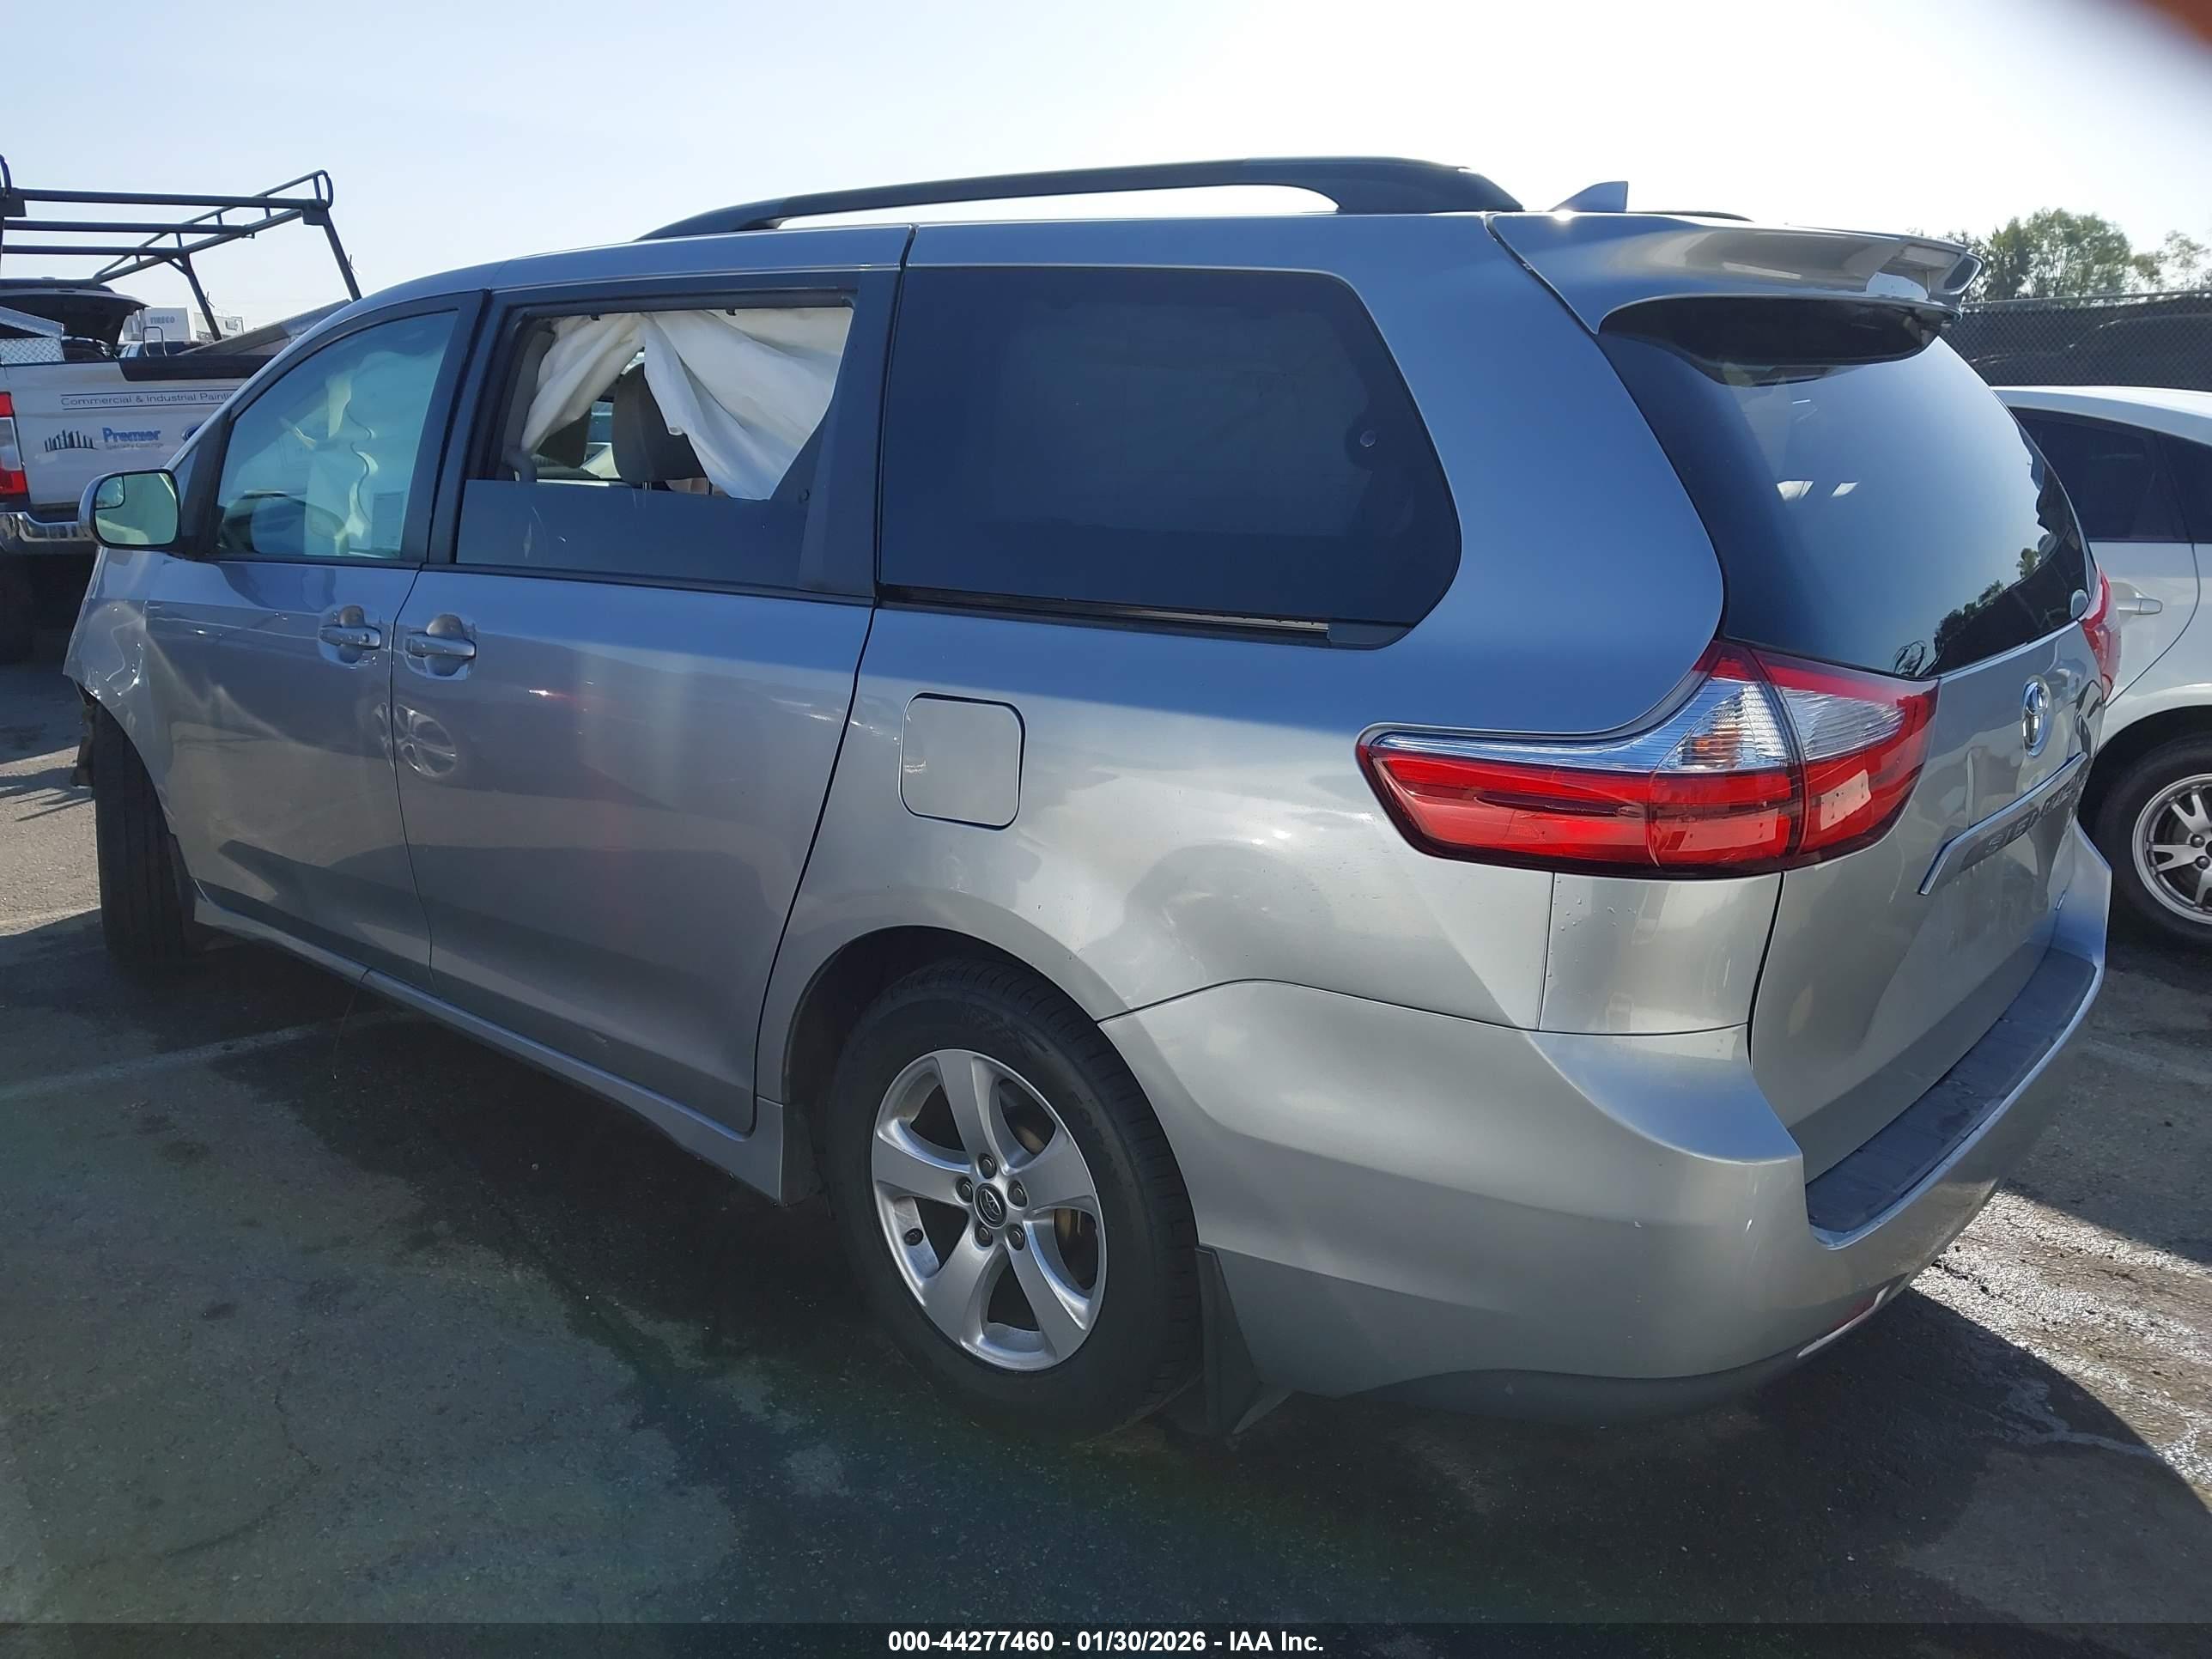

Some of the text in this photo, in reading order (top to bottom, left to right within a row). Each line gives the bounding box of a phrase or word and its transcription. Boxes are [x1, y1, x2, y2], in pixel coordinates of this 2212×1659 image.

[61, 393, 131, 406] Commercial
[136, 395, 143, 404] &
[146, 392, 197, 404] Industrial
